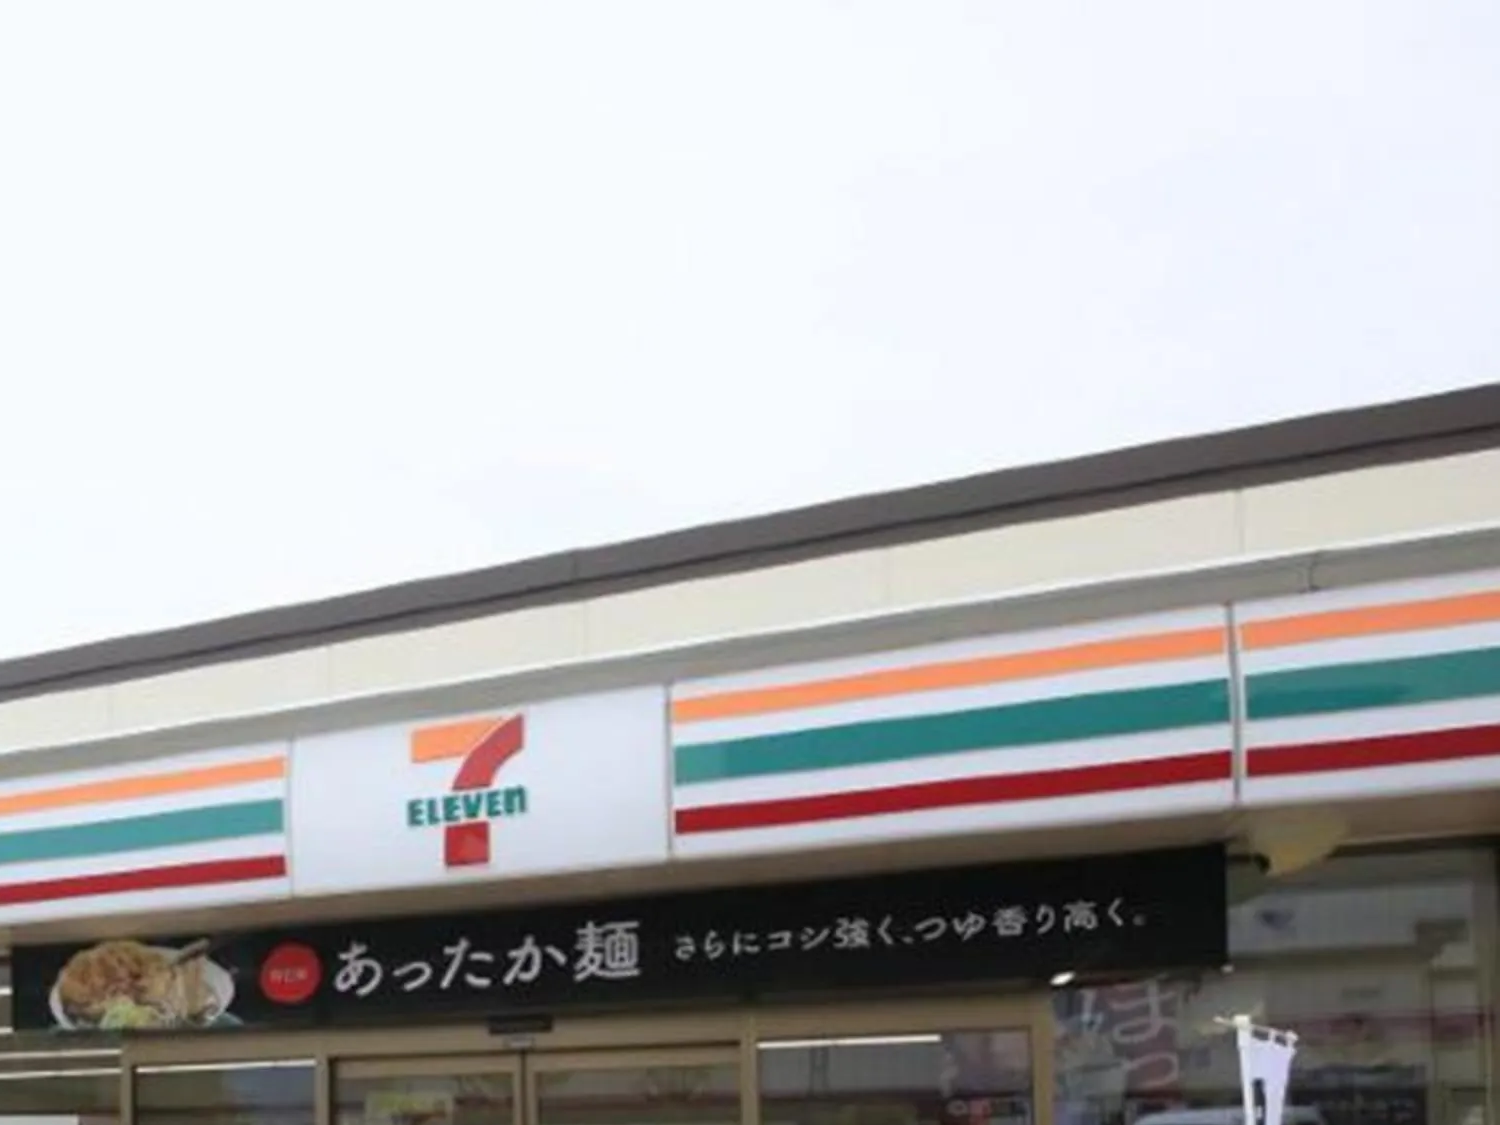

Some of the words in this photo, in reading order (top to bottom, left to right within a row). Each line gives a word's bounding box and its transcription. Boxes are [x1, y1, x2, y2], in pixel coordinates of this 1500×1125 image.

[333, 918, 642, 998] あったか麺
